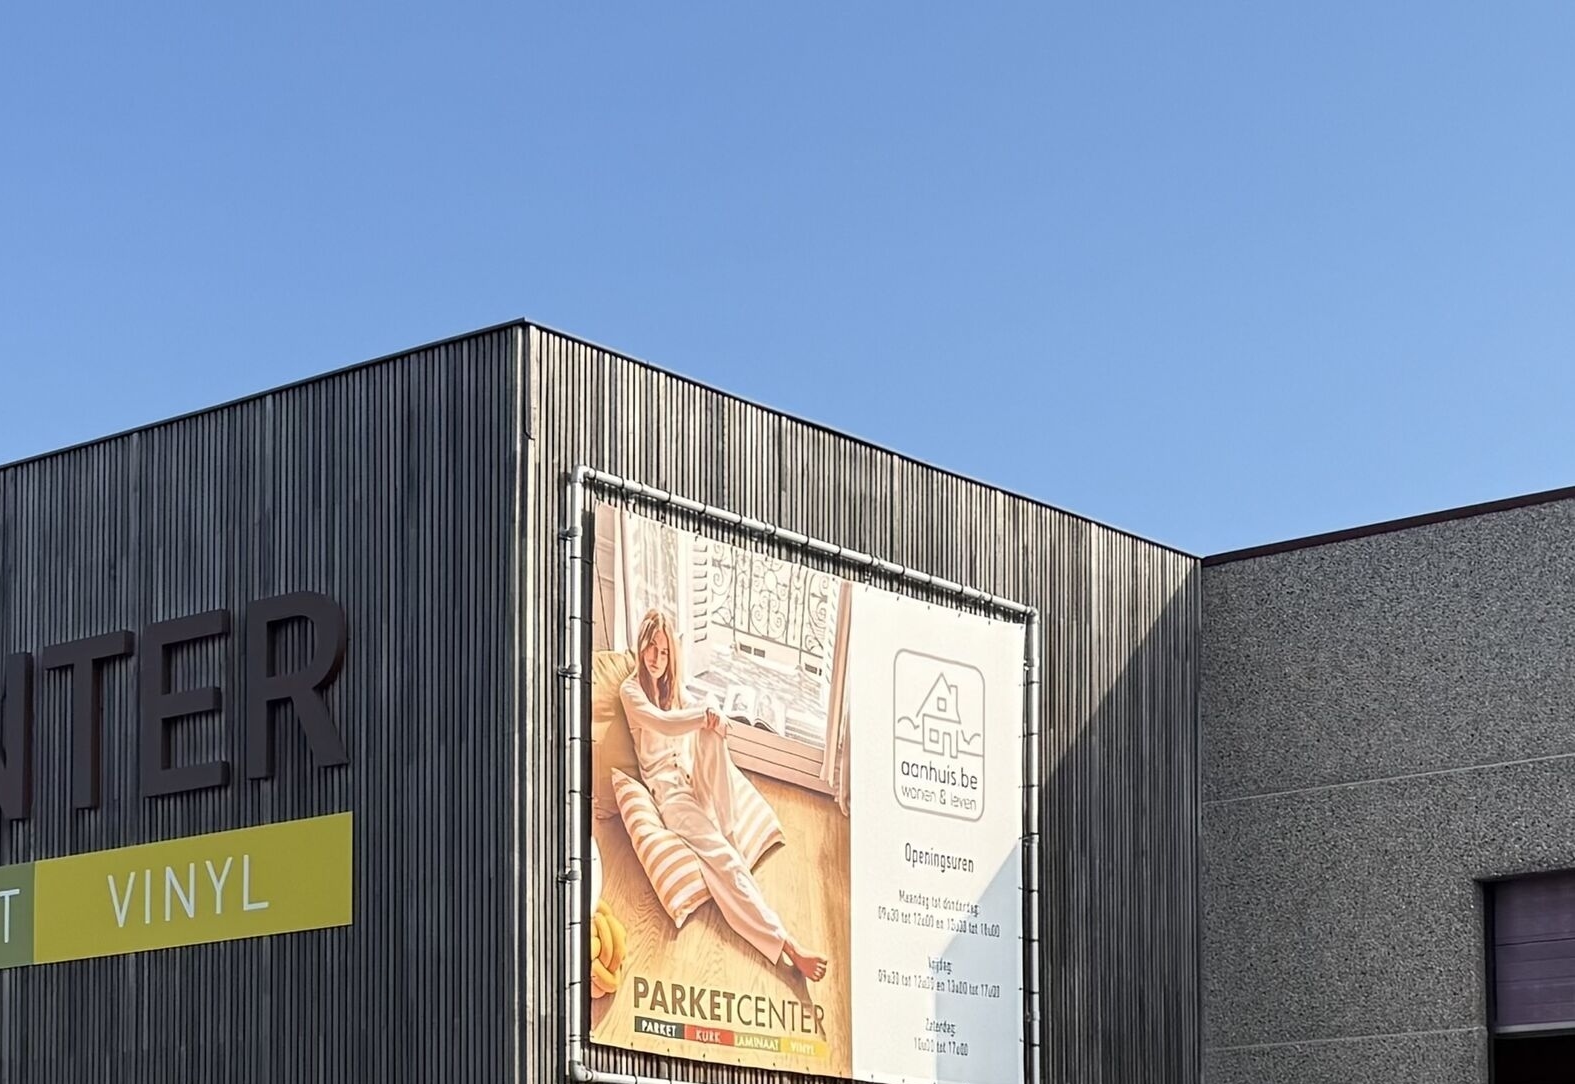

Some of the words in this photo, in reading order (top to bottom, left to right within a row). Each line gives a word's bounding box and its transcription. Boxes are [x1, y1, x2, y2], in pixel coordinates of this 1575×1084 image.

[901, 760, 978, 790] aanhuis.be
[901, 785, 937, 803] wonen
[939, 788, 946, 805] &
[950, 791, 977, 811] leven
[905, 842, 974, 873] Openingsuren
[107, 854, 269, 928] VINYL
[633, 976, 826, 1036] PARKETCENTER
[641, 1020, 676, 1037] PARKET
[695, 1029, 721, 1044] KURK
[736, 1033, 779, 1051] LAMINAAT
[790, 1040, 816, 1055] VINYL
